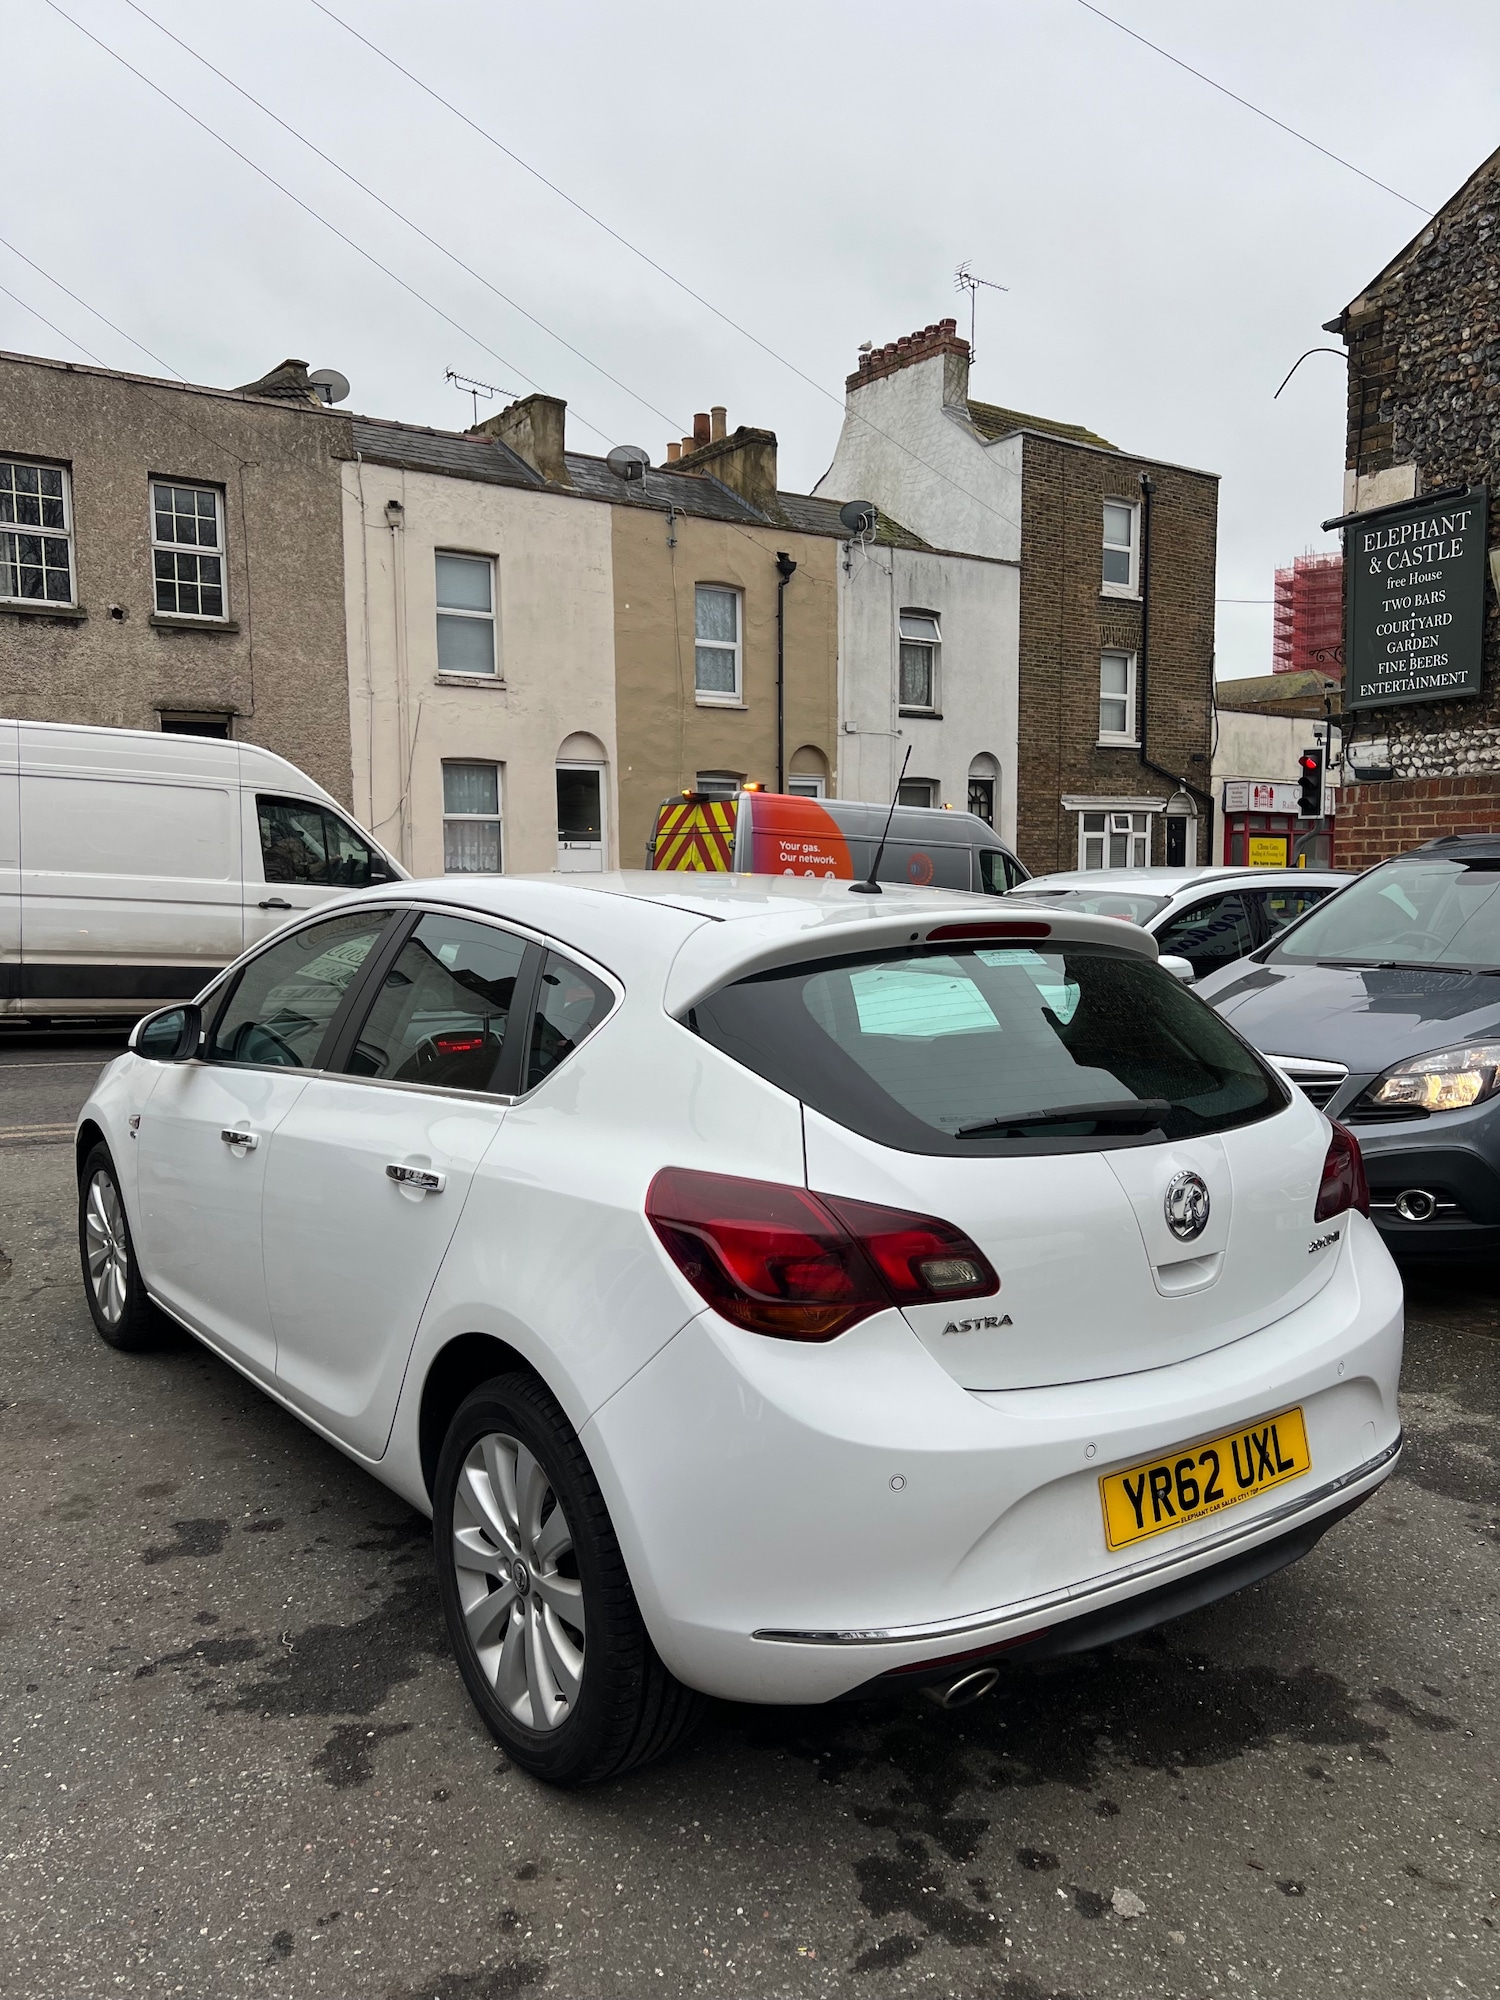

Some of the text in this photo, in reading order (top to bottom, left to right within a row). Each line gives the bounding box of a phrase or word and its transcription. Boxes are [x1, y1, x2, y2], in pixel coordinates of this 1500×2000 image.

[1363, 510, 1472, 553] ELEPHANT
[1369, 538, 1464, 575] & CASTLE
[1387, 569, 1443, 590] free House
[1382, 590, 1447, 613] TWO BARS
[1375, 612, 1453, 637] COURTYARD
[1386, 635, 1440, 654] GARDEN
[1378, 653, 1449, 675] FINE BEERS
[1360, 670, 1469, 697] ENTERTAINMENT
[779, 841, 821, 853] Your gas.
[780, 852, 837, 865] Our network.
[941, 1313, 1014, 1336] ASTRA
[1122, 1424, 1295, 1529] YR62 UXL
[1180, 1508, 1209, 1523] ELEPHANT
[1209, 1503, 1221, 1512] CAR
[1221, 1497, 1237, 1508] SALES
